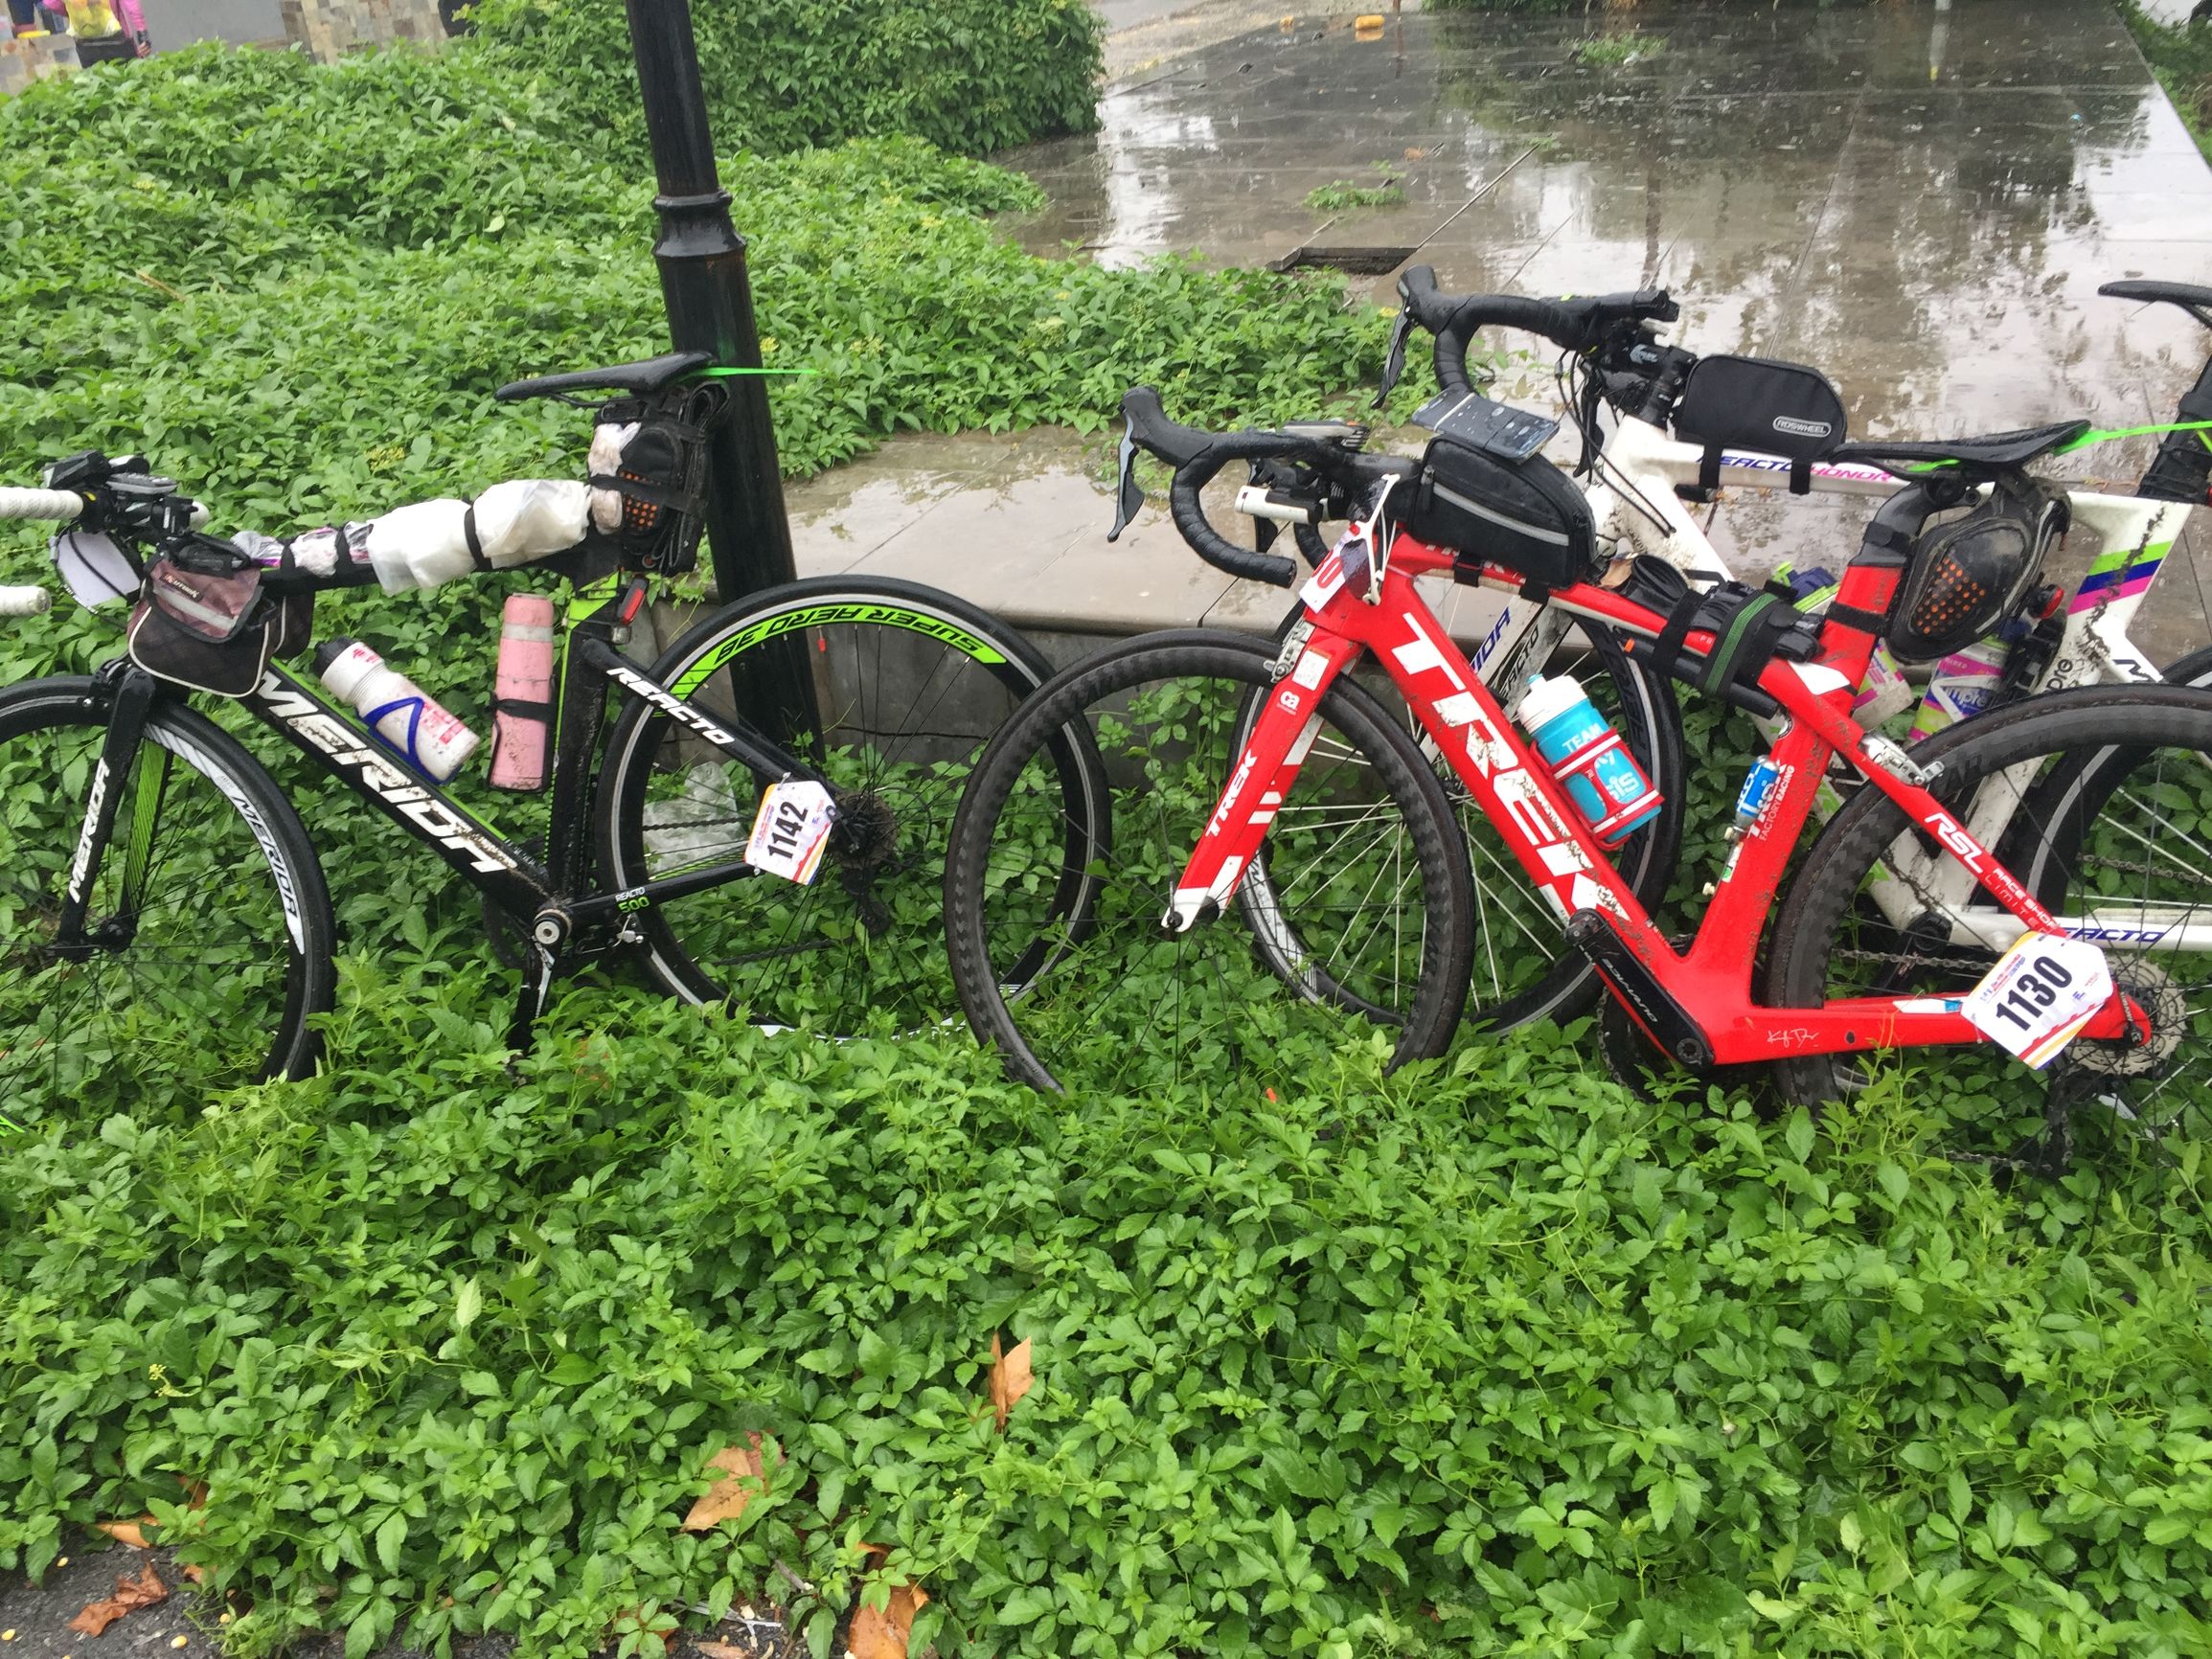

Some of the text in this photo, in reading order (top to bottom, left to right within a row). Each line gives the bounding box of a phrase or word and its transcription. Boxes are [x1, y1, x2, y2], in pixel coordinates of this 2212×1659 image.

[1777, 418, 1827, 435] ROSWHEEL
[769, 606, 864, 634] AERO
[865, 607, 985, 652] SUPER
[1471, 606, 1511, 672] IDA
[606, 667, 736, 744] REACTO
[2047, 657, 2074, 691] pre
[258, 670, 517, 873] MERIDA
[1205, 749, 1258, 837] TREK
[1391, 612, 1631, 922] TREK
[68, 757, 110, 904] MERIDA
[767, 801, 809, 859] 1142
[1759, 799, 1783, 842] FACTORY
[1776, 764, 1795, 802] RACING
[232, 796, 298, 919] MERIDA
[1925, 812, 1984, 874] RSL
[615, 886, 646, 902] REACTO
[618, 896, 650, 913] 500
[1992, 867, 2027, 900] RACE
[1995, 956, 2073, 1032] 1130
